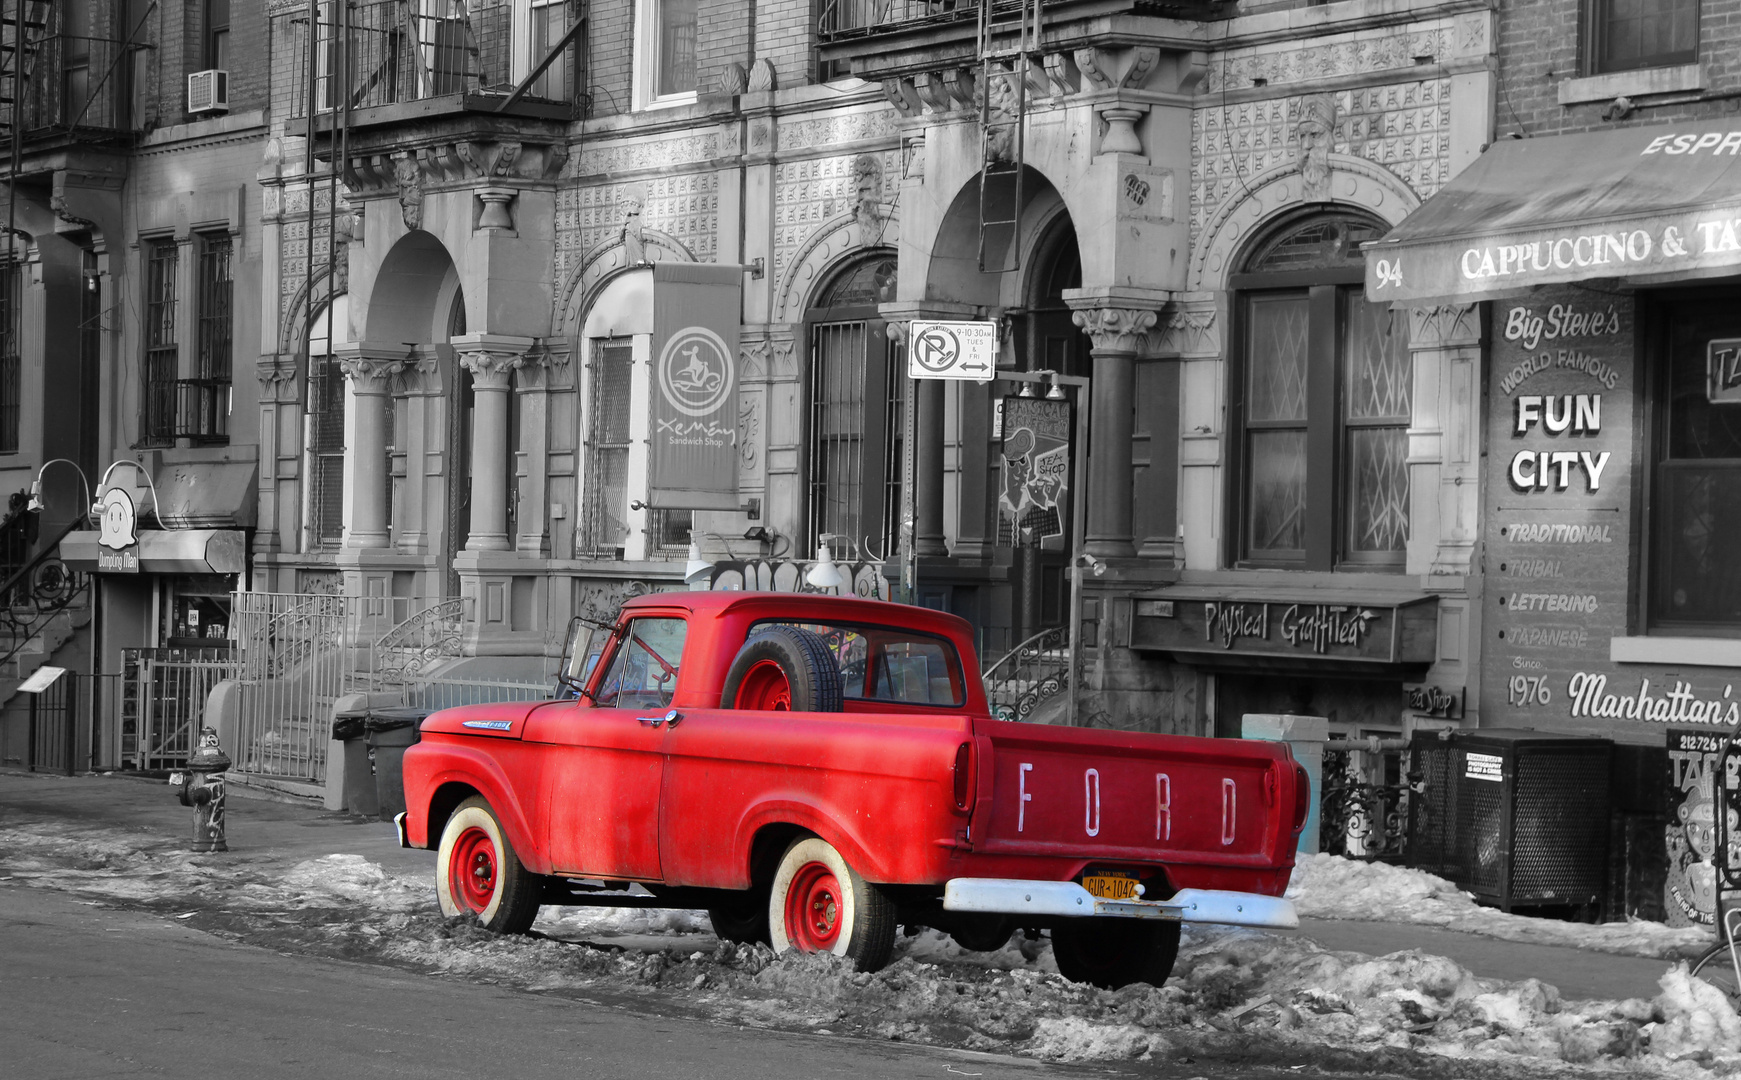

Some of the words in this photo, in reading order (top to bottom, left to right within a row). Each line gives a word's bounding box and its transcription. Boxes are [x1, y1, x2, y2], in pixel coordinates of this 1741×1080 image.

[1461, 229, 1652, 280] CAPPUCCINO
[1661, 226, 1688, 257] &
[1697, 217, 1741, 254] TA
[1376, 257, 1403, 290] 94
[1505, 306, 1544, 350] Big
[1544, 303, 1620, 339] Steve's
[1500, 351, 1551, 394] WORLD
[1557, 349, 1619, 389] FAMOUS
[1515, 394, 1601, 433] FUN
[669, 436, 704, 445] Sandwich
[704, 437, 724, 448] Shop
[1039, 463, 1067, 476] SHOP
[1042, 453, 1063, 466] TEA
[1510, 449, 1611, 490] CITY
[1509, 523, 1613, 543] TRADITIONAL
[98, 551, 123, 571] Dumpling
[123, 551, 137, 568] Man
[1510, 559, 1564, 578] TRIBAL
[1508, 593, 1599, 614] LETTERING
[206, 624, 225, 639] ATM
[1205, 601, 1268, 649] Physical
[1507, 627, 1589, 648] JAPANESE
[1512, 656, 1543, 669] Since
[1402, 682, 1424, 708] Tea
[1425, 686, 1452, 718] Shop
[1508, 674, 1552, 707] 1976
[1567, 671, 1740, 726] Manhattan's
[1018, 763, 1237, 846] FORD
[1088, 878, 1106, 898] GUR
[1112, 880, 1135, 899] 1042
[1670, 885, 1690, 912] FRIEND
[1688, 908, 1699, 919] OF
[1699, 911, 1715, 924] THE
